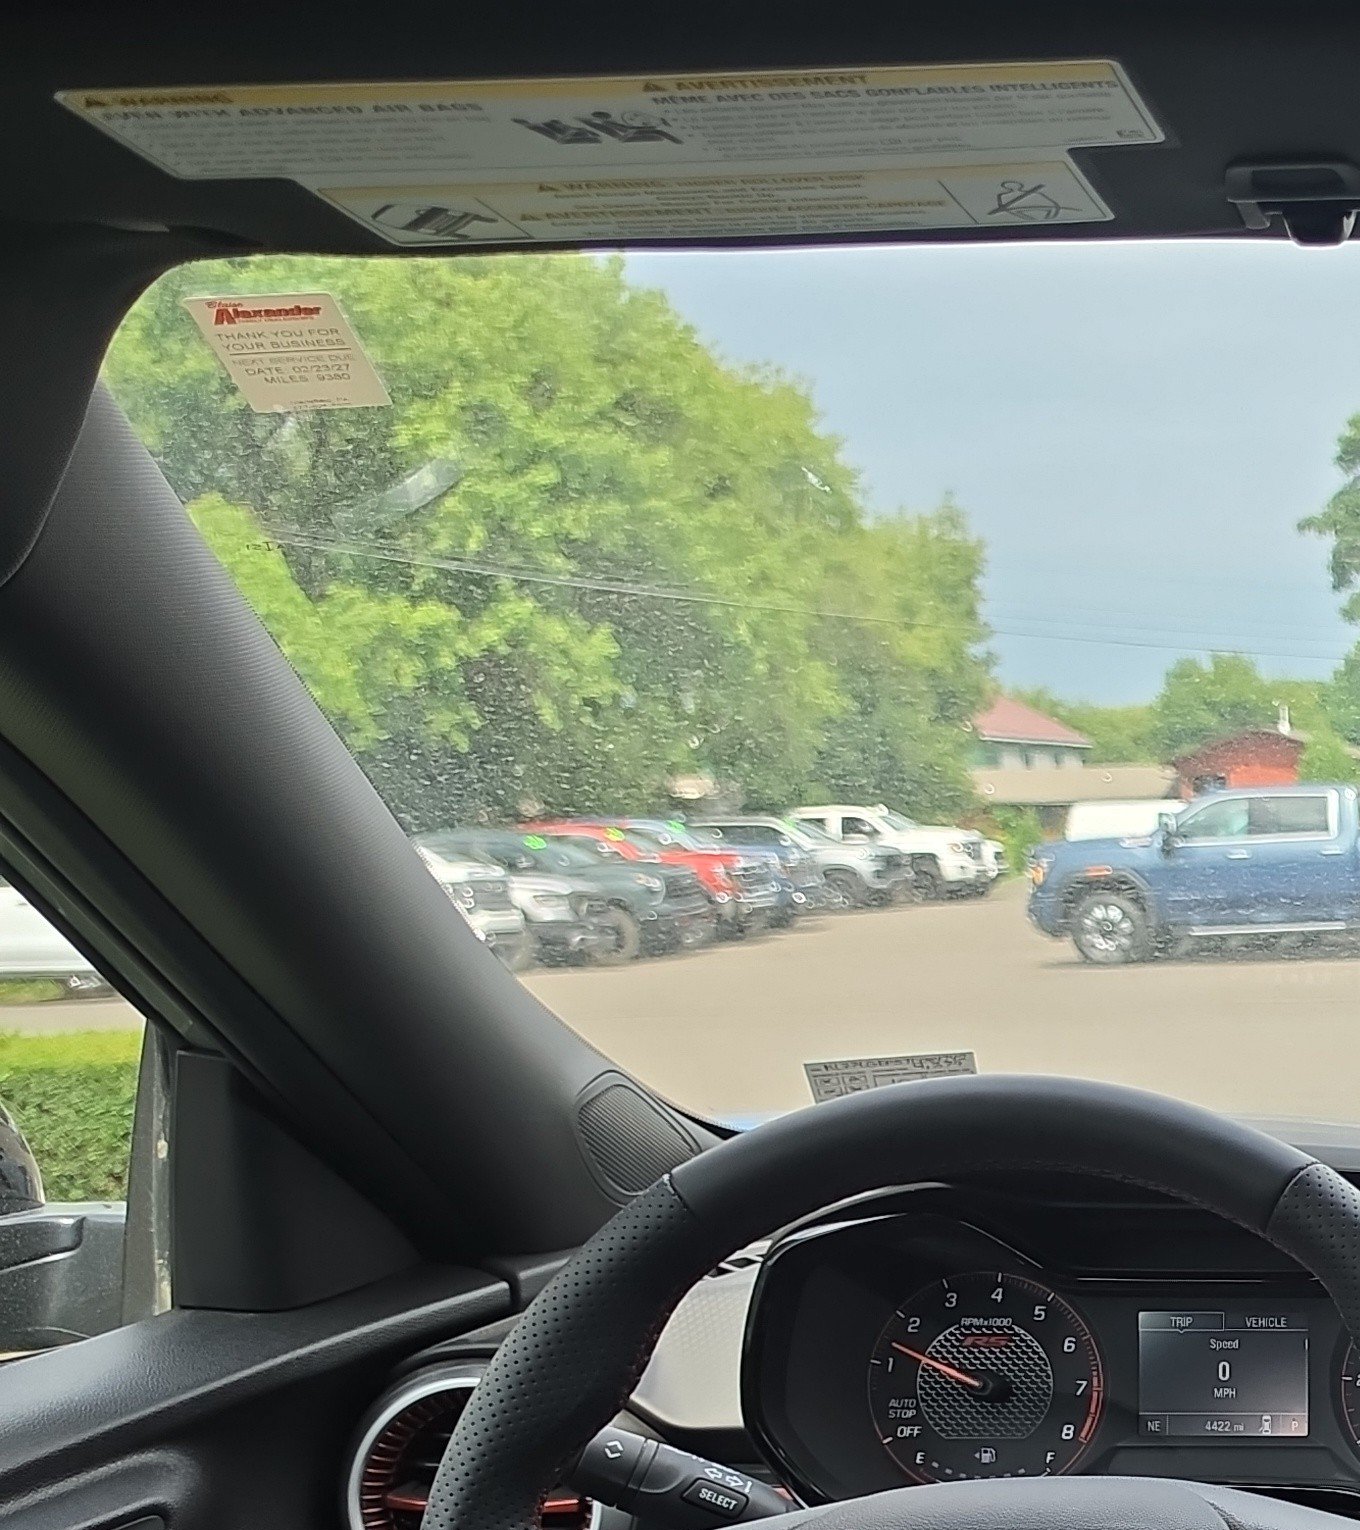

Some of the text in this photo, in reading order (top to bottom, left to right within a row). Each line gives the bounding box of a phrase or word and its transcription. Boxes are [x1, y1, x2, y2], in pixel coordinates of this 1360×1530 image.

[717, 92, 765, 103] AVEC
[810, 89, 861, 99] SACS
[372, 103, 412, 113] AIR
[214, 305, 321, 325] Alexander
[216, 327, 339, 342] THANK YOU FOR
[222, 338, 346, 351] YOUR BUSINESS
[264, 375, 309, 384] MILES
[945, 1292, 958, 1308] 3
[991, 1288, 1003, 1303] 4
[1033, 1306, 1047, 1321] 5
[907, 1317, 920, 1333] 2
[1170, 1317, 1193, 1327] TRIP
[1245, 1317, 1287, 1328] VEHICLE
[963, 1336, 1013, 1347] RS
[1063, 1337, 1076, 1352] 6
[1210, 1338, 1239, 1351] Speed
[887, 1357, 894, 1373] 1
[1218, 1361, 1230, 1381] 0
[1075, 1380, 1088, 1396] 7
[1214, 1387, 1236, 1399] MPH
[888, 1398, 917, 1408] AUTO
[888, 1409, 917, 1419] STOP
[897, 1426, 922, 1437] OFF
[1061, 1424, 1075, 1440] 8
[1147, 1421, 1161, 1431] NE
[1205, 1421, 1244, 1432] 4422 mi
[1291, 1420, 1298, 1431] P
[915, 1452, 925, 1464] E
[1046, 1452, 1055, 1464] F
[699, 1488, 738, 1511] SELECT
